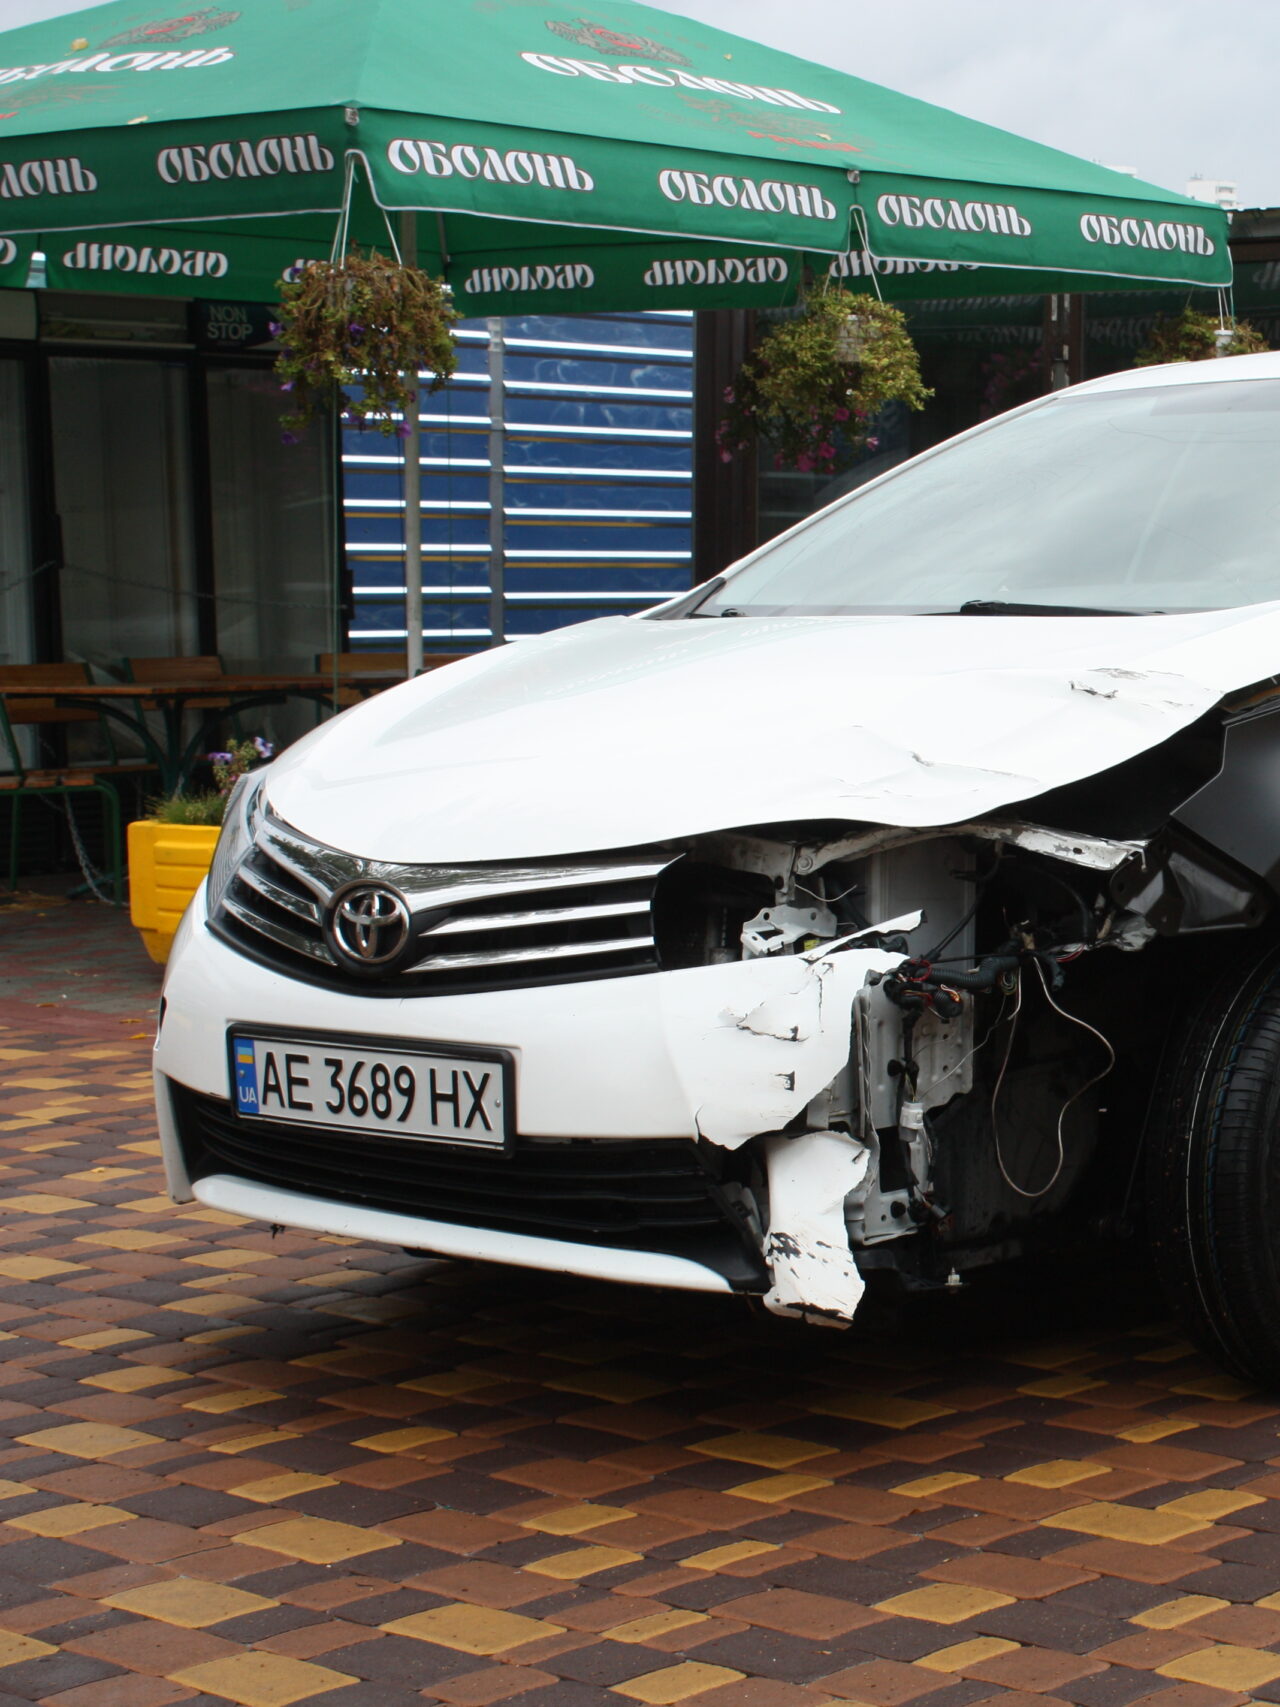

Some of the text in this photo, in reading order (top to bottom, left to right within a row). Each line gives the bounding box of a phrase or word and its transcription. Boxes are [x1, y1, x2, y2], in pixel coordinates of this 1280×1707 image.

[521, 52, 842, 114] ОБОЛОНЬ
[158, 135, 334, 183] ОБОЛОНЬ
[388, 140, 594, 191] ОБОЛОНЬ
[659, 169, 837, 220] ОБОЛОНЬ
[878, 194, 1032, 236] ОБОЛОНЬ
[1080, 214, 1215, 256] ОБОЛОНЬ
[207, 322, 253, 340] STOP
[209, 305, 247, 322] NON
[239, 1086, 257, 1104] UA
[262, 1051, 493, 1131] AE 3689 HX
